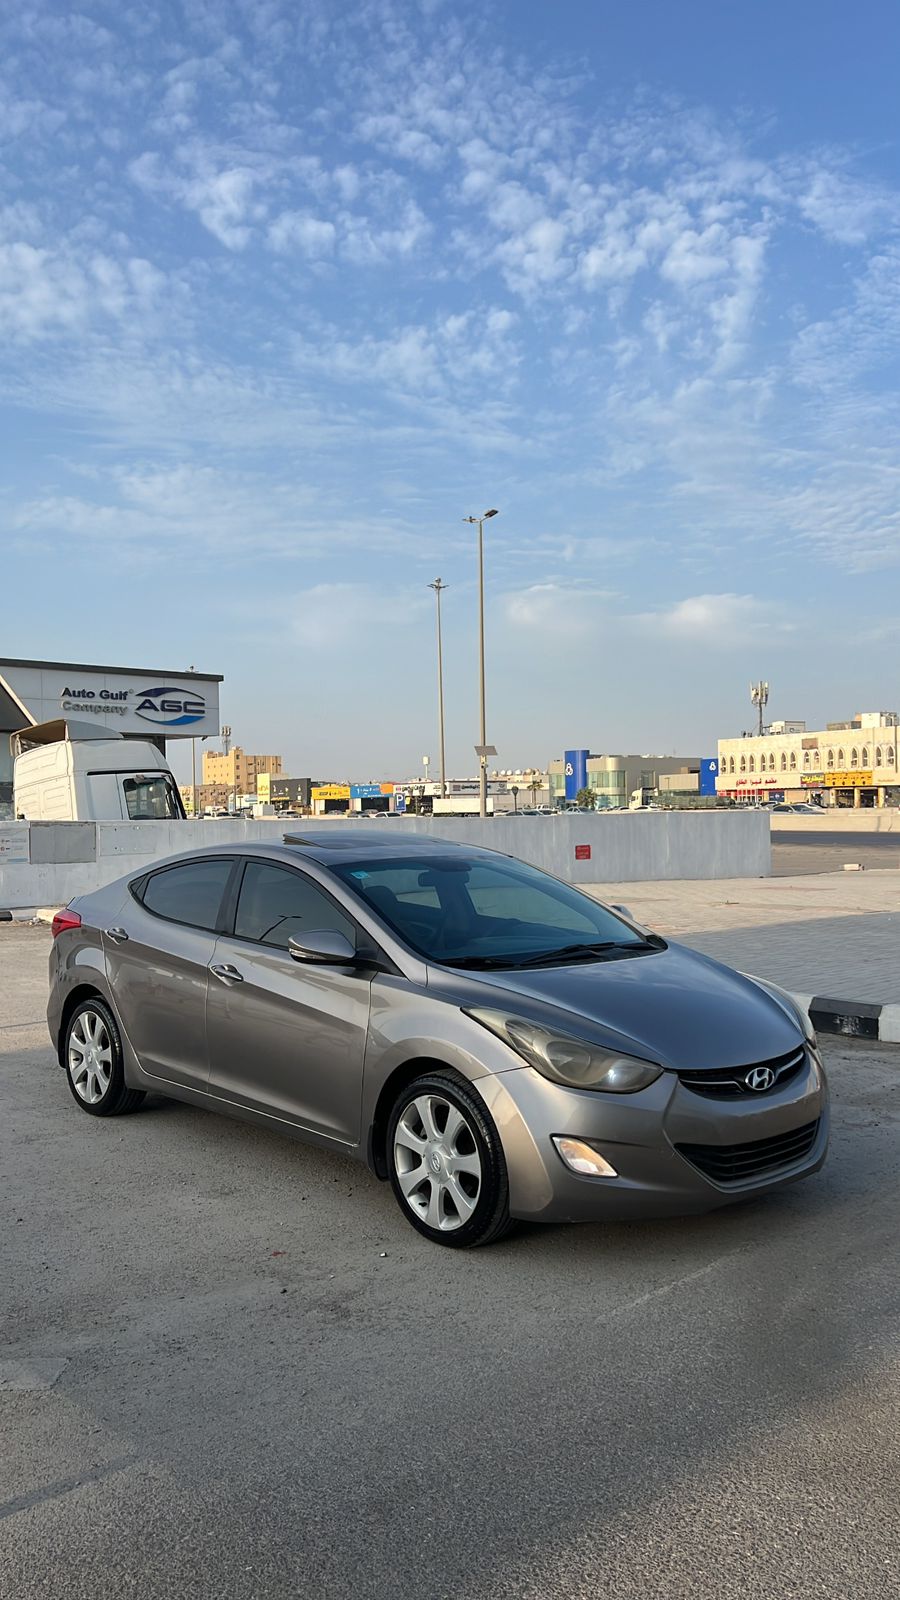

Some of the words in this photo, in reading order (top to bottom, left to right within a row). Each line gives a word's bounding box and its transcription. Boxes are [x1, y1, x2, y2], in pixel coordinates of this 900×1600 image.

[62, 687, 95, 699] Auto
[99, 689, 128, 701] Gulf
[62, 701, 128, 716] Company
[136, 699, 205, 714] AGC
[396, 794, 404, 806] P
